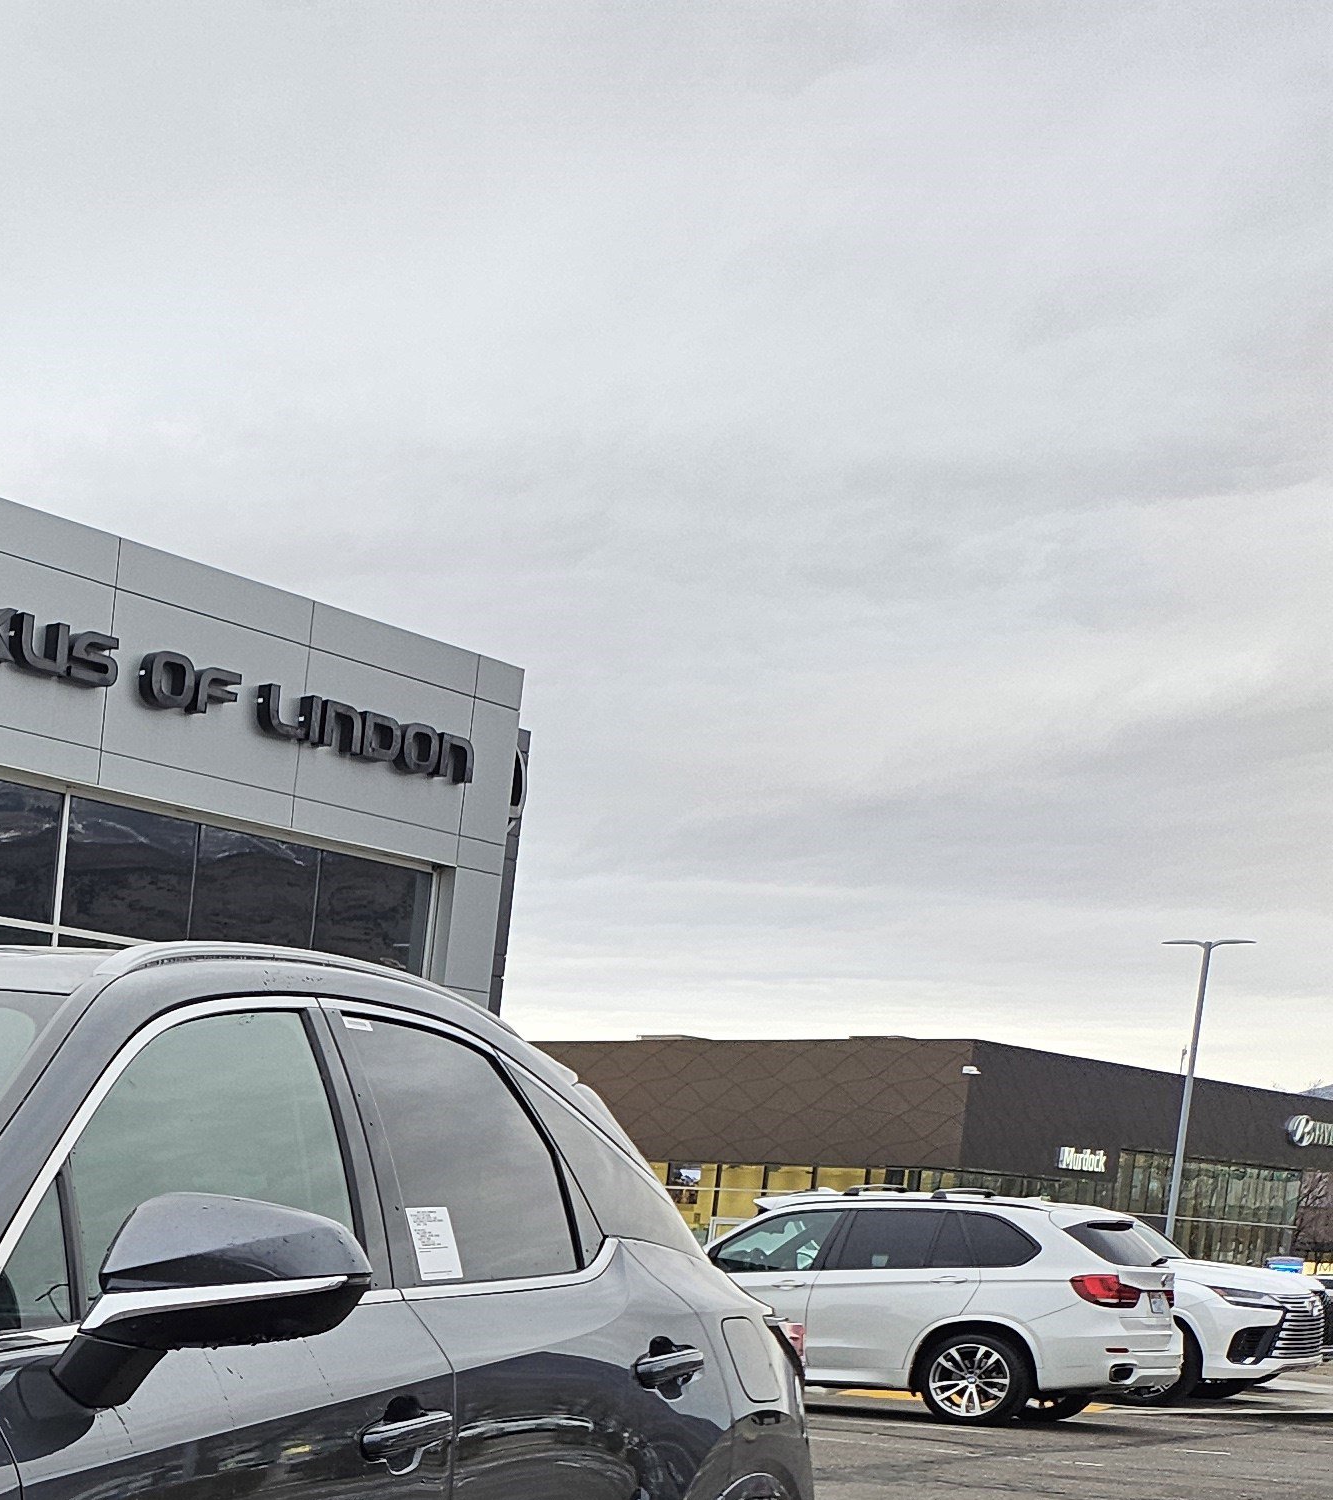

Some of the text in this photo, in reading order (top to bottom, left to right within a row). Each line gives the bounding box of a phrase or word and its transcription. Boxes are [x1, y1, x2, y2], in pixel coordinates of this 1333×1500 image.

[138, 650, 243, 714] OF
[256, 683, 475, 785] LINDON
[1058, 1146, 1107, 1173] Murdock
